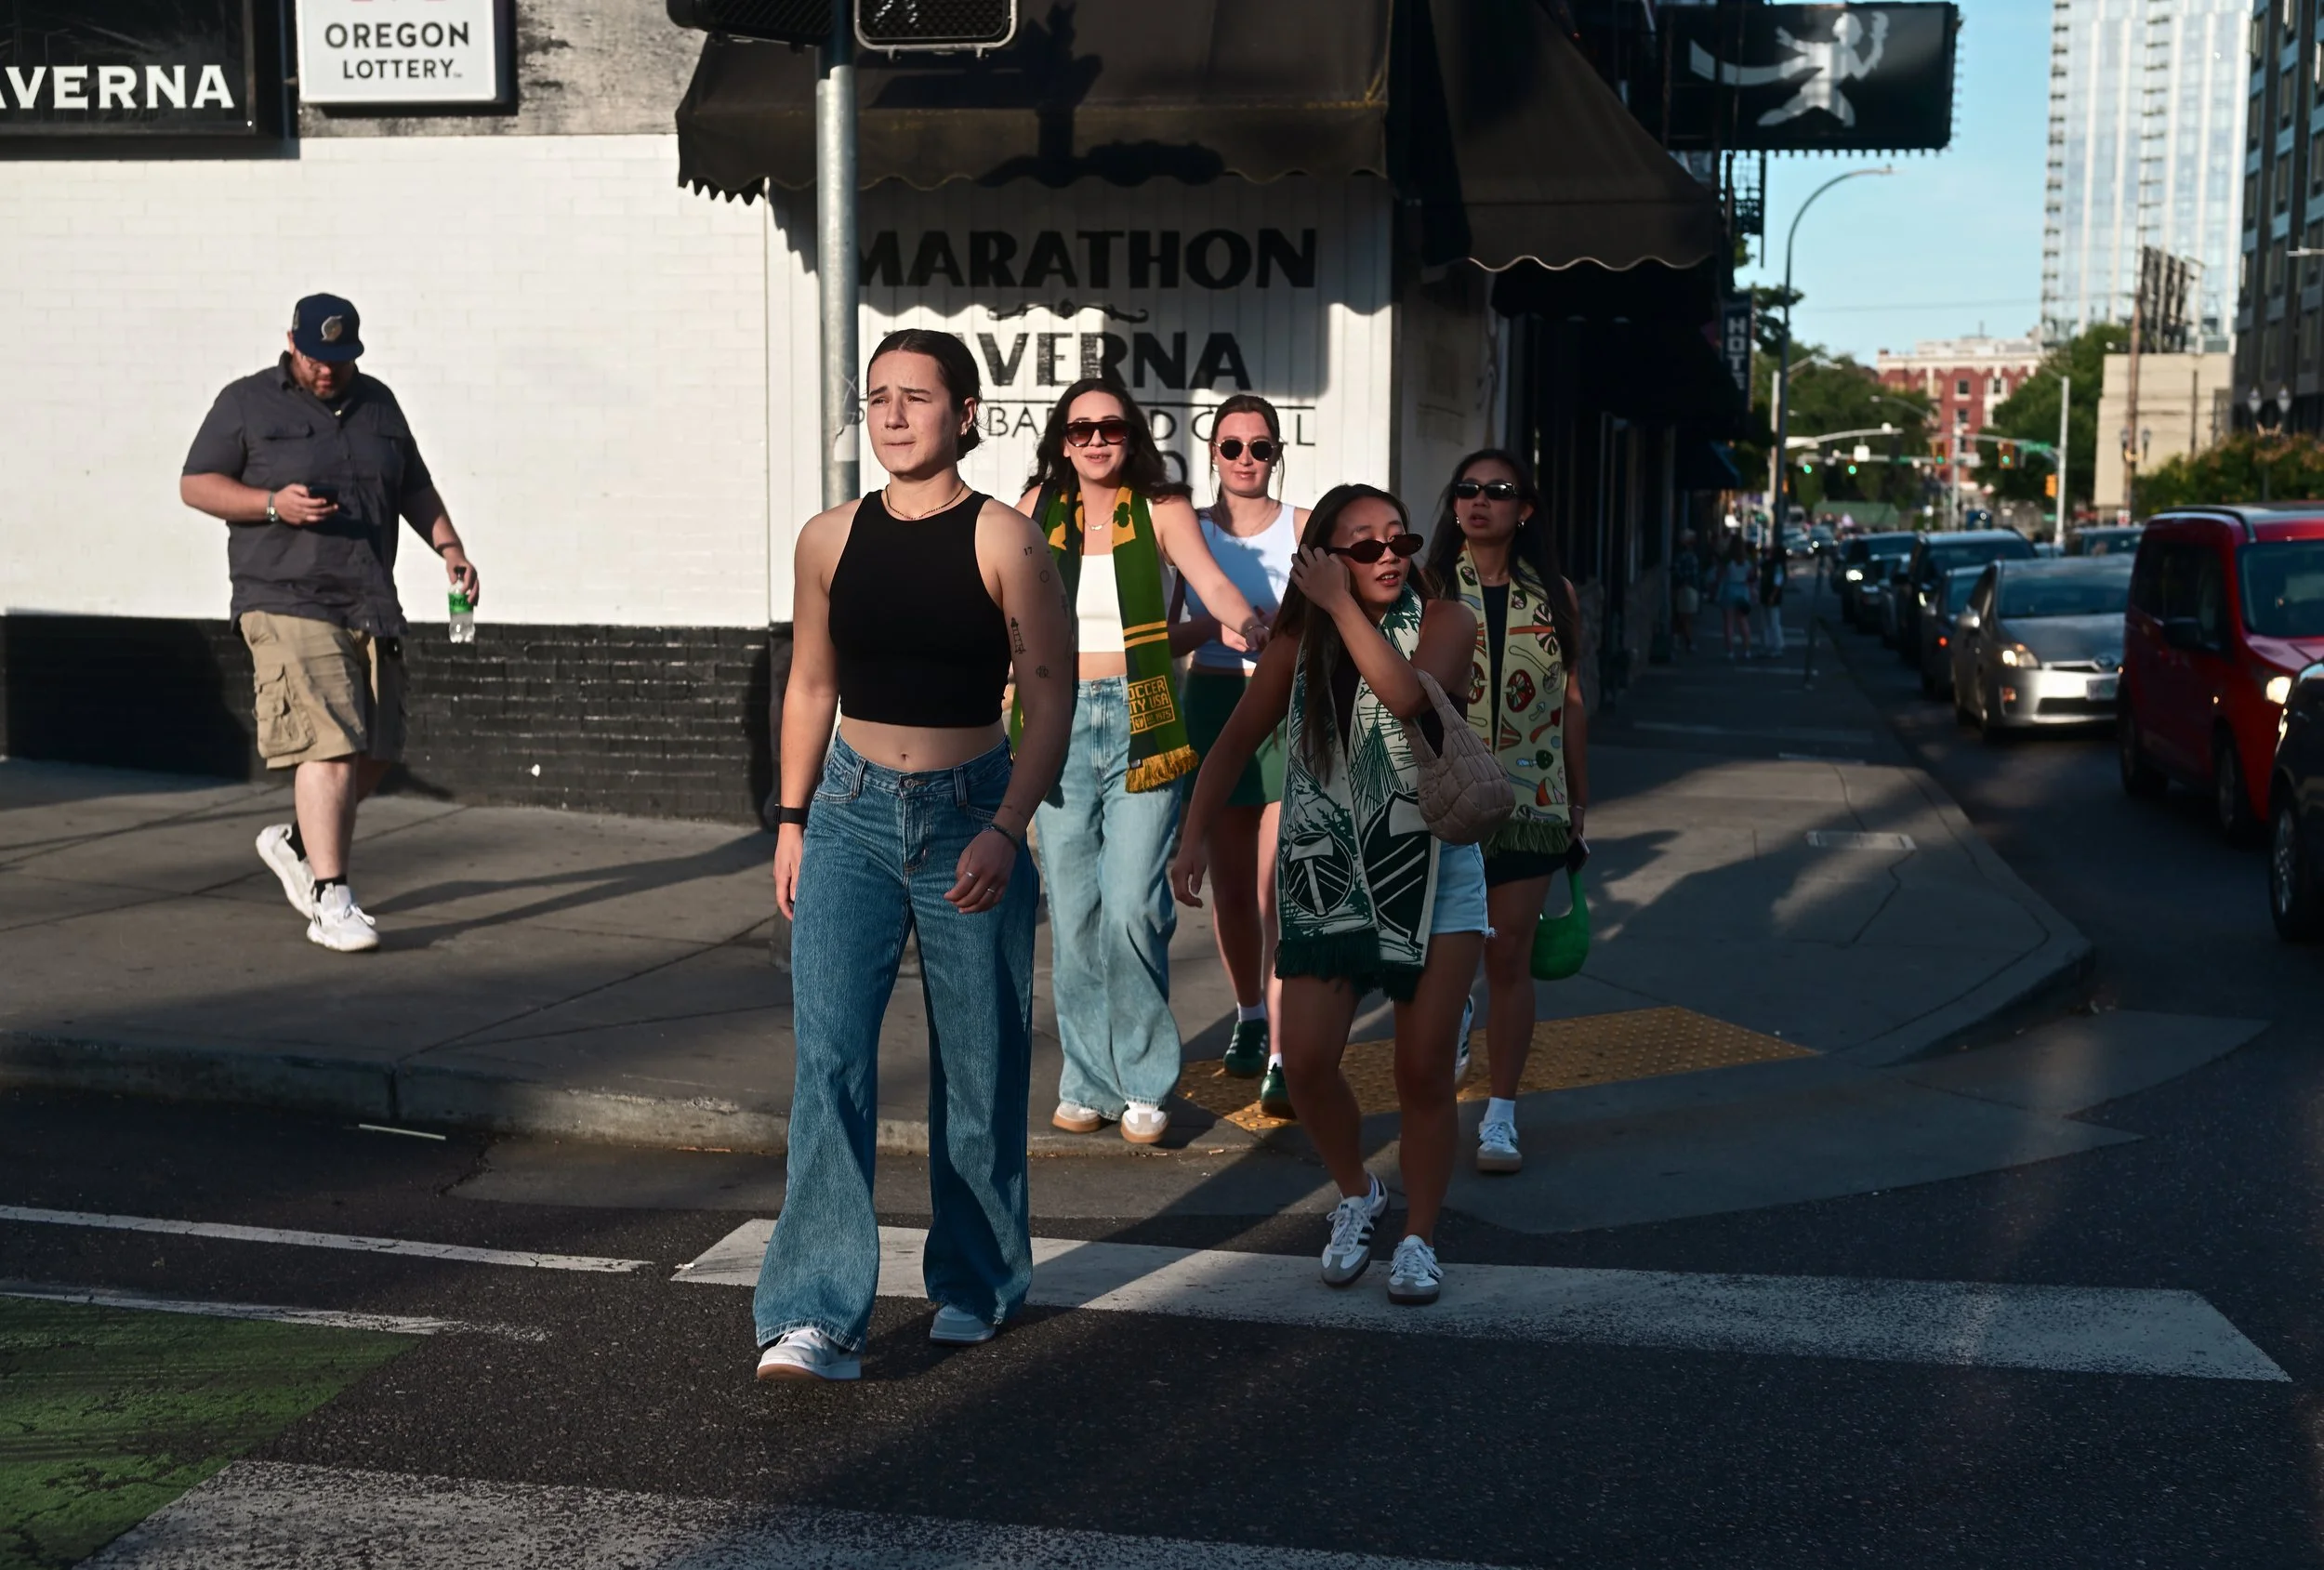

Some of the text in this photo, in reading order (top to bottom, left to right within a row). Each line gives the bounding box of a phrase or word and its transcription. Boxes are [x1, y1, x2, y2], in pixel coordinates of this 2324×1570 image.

[325, 21, 469, 48] OREGON
[343, 59, 454, 79] LOTTERY
[0, 65, 235, 110] VERNA
[883, 331, 1252, 390] VERNA
[1023, 547, 1033, 556] 17
[1129, 679, 1166, 701] OCCER
[1129, 693, 1169, 714] ITY USA
